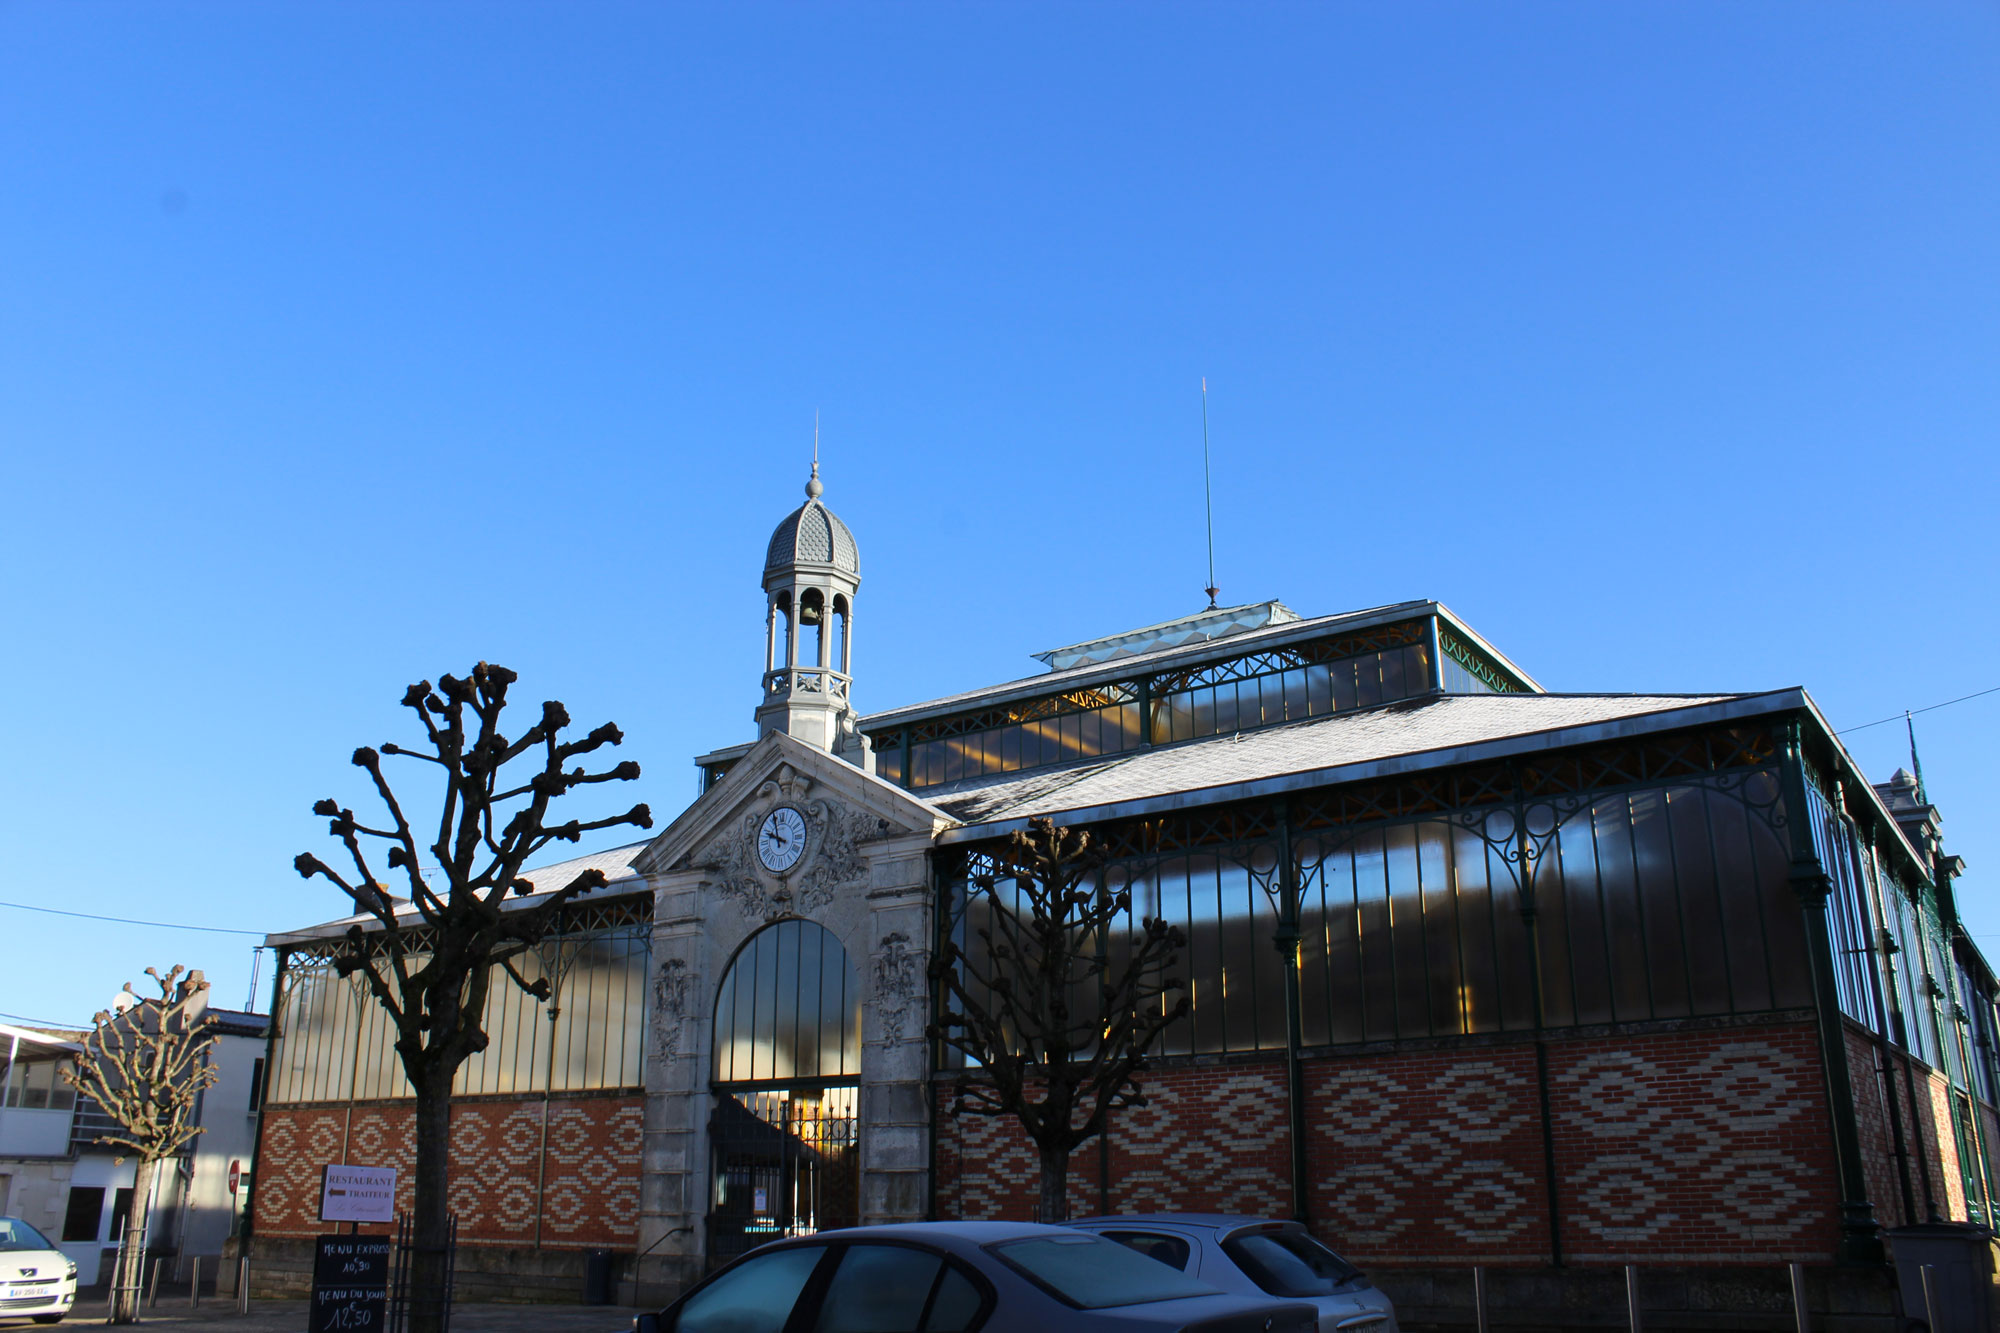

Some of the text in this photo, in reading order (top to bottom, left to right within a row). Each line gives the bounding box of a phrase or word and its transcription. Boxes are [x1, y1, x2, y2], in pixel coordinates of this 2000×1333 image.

[329, 1175, 392, 1186] RESTAURANT
[349, 1190, 391, 1199] TRAITEUR
[324, 1243, 390, 1256] MENU EXPRESS
[319, 1289, 347, 1305] MENU
[350, 1289, 363, 1299] DU
